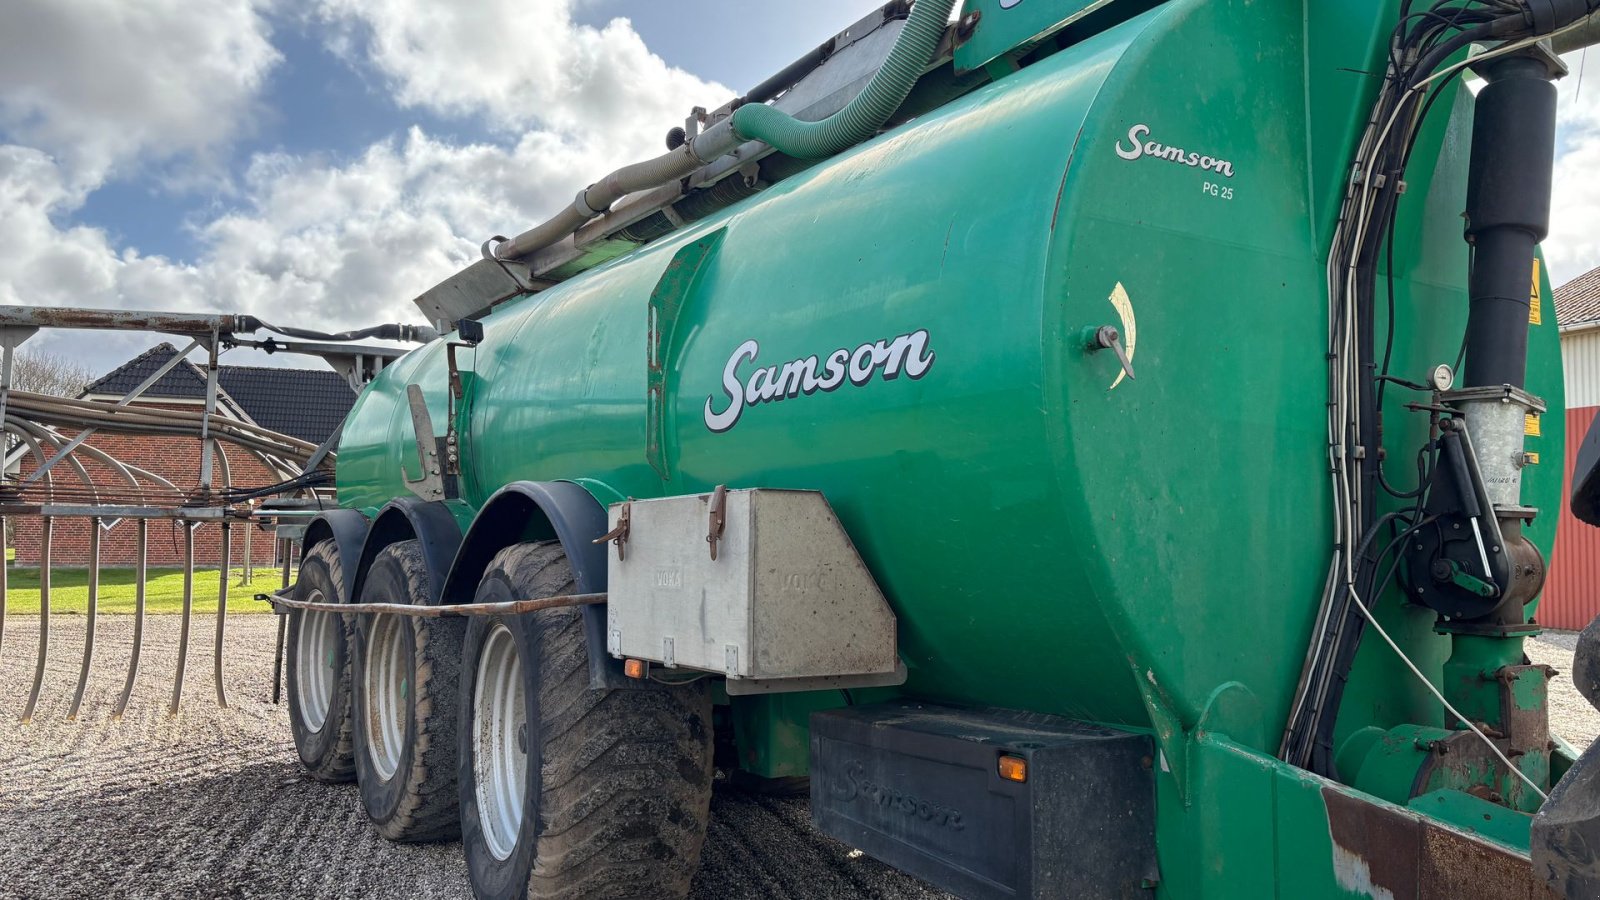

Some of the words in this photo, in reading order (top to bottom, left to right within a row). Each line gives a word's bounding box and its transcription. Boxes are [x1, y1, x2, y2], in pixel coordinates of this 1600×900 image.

[1115, 123, 1235, 177] Samson
[1202, 181, 1218, 196] PG
[1221, 186, 1233, 200] 25
[704, 328, 935, 434] Samson
